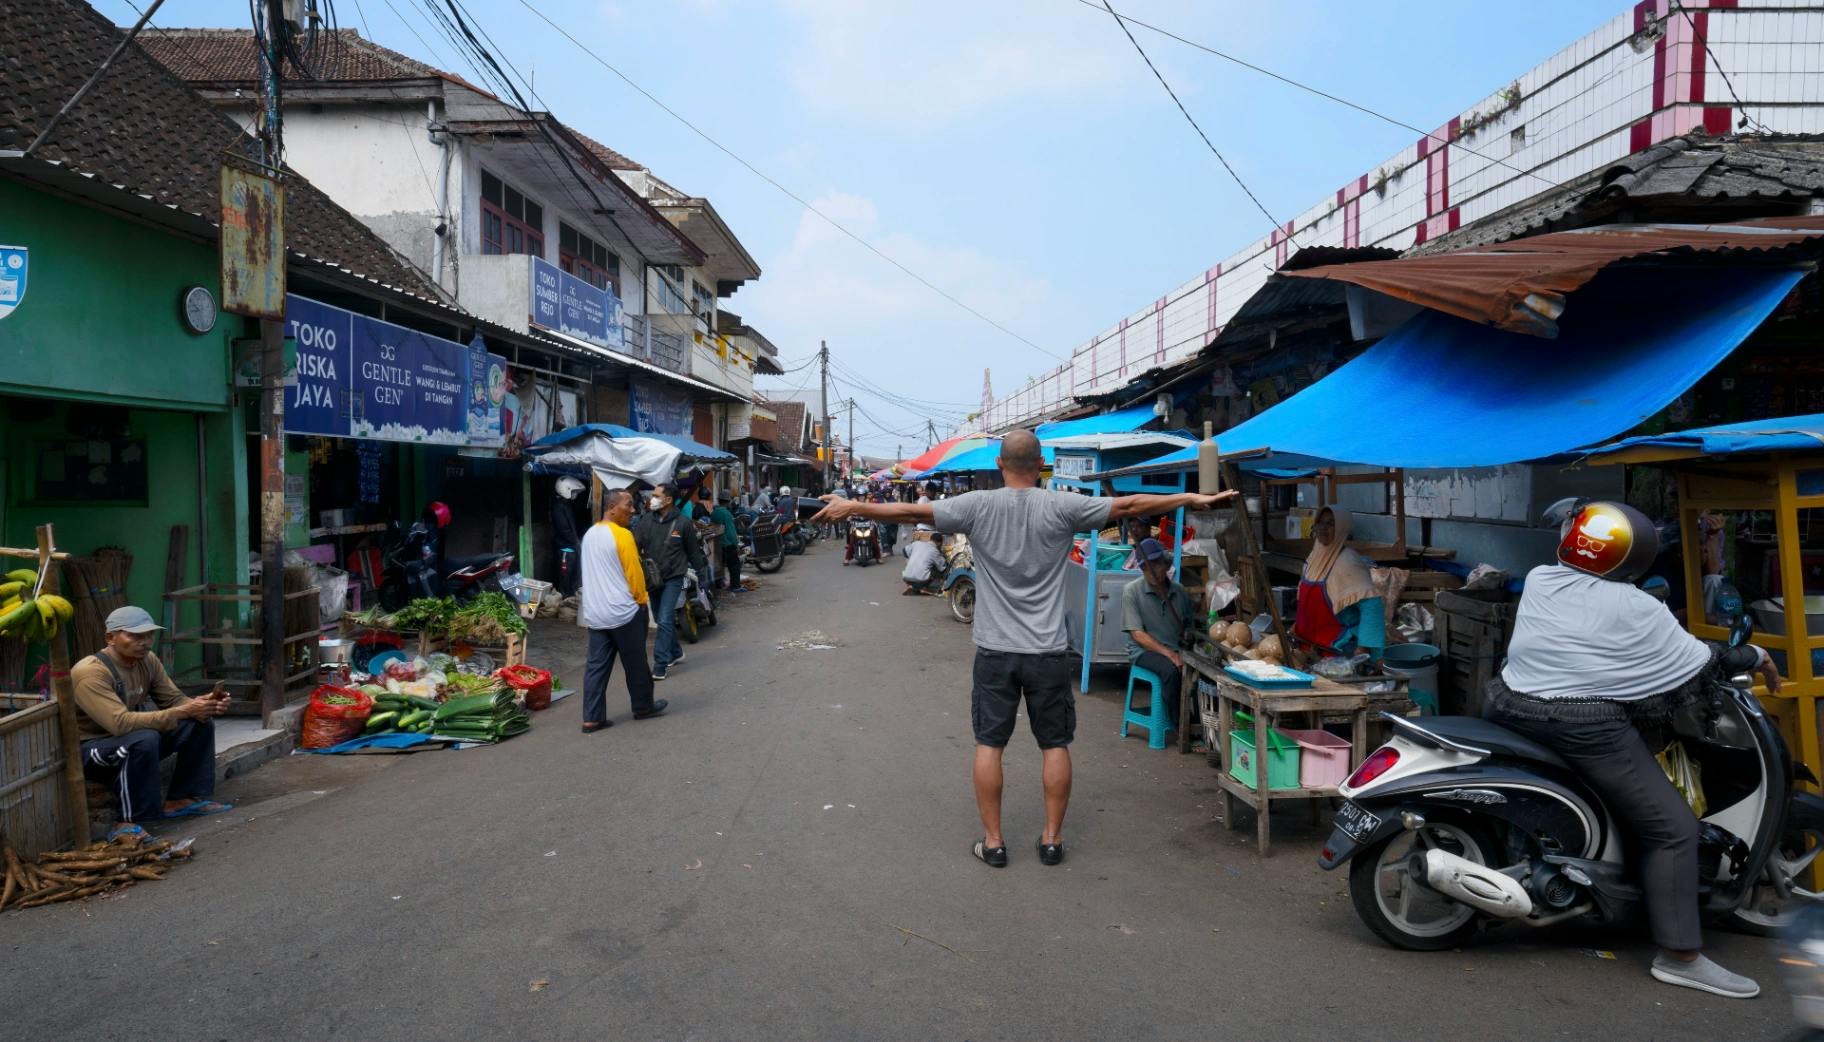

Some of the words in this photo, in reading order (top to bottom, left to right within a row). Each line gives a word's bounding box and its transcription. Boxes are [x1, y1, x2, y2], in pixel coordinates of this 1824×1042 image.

[540, 271, 556, 287] TOKO
[536, 284, 558, 303] SUMBER
[540, 300, 554, 316] REJO
[291, 320, 336, 351] TOKO
[296, 352, 336, 380] RISKA
[362, 361, 412, 387] GENTLE
[415, 375, 435, 388] WANGI
[441, 381, 461, 393] LEMBUT
[294, 382, 333, 408] JAYA
[425, 391, 431, 402] DI
[432, 392, 453, 405] TANGAN
